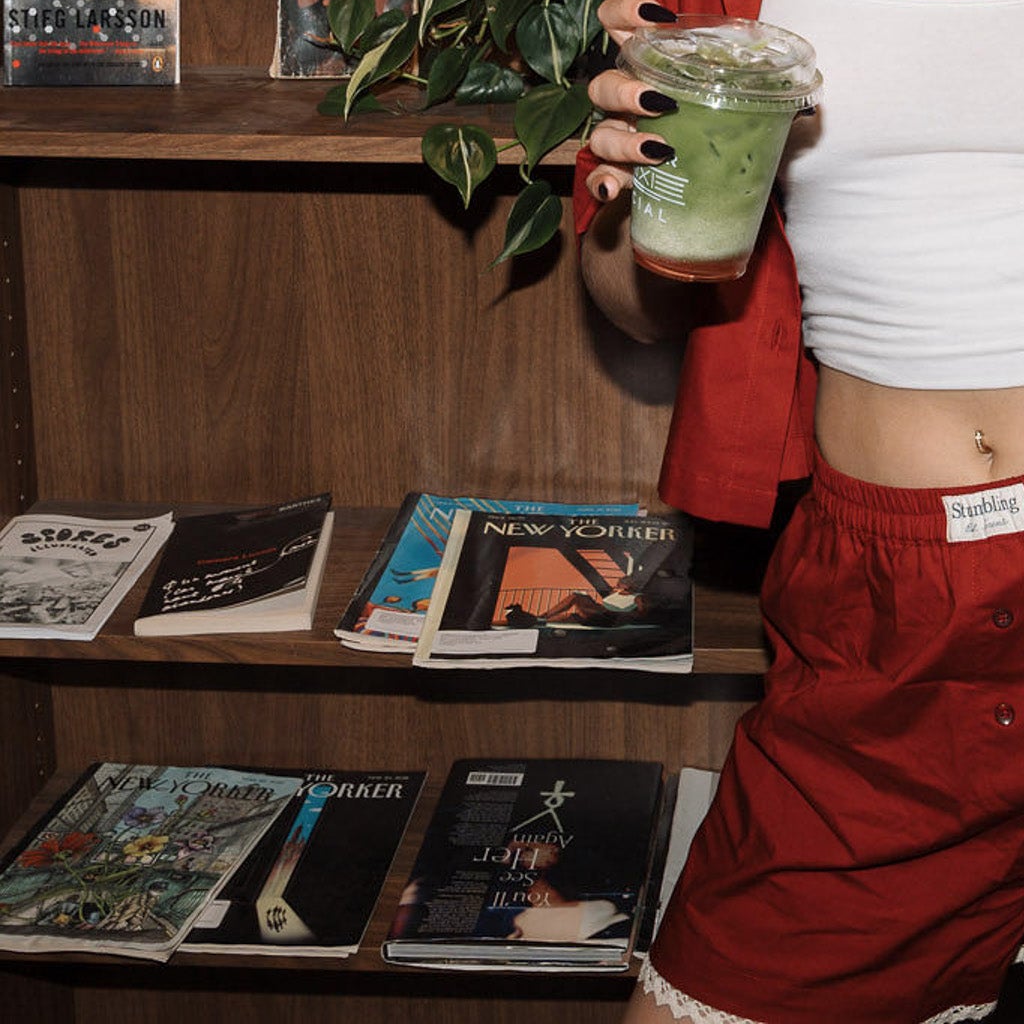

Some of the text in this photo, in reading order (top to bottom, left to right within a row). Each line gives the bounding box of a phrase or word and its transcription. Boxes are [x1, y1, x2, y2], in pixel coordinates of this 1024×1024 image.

[8, 9, 165, 29] STIEG LARSSON
[484, 521, 677, 542] NEW YORKER
[305, 773, 334, 782] THE
[105, 776, 275, 801] NEW YORKER
[296, 781, 403, 799] YORKER
[512, 830, 574, 849] Again
[473, 847, 539, 870] Her
[499, 870, 538, 885] See
[492, 891, 552, 908] You'll
